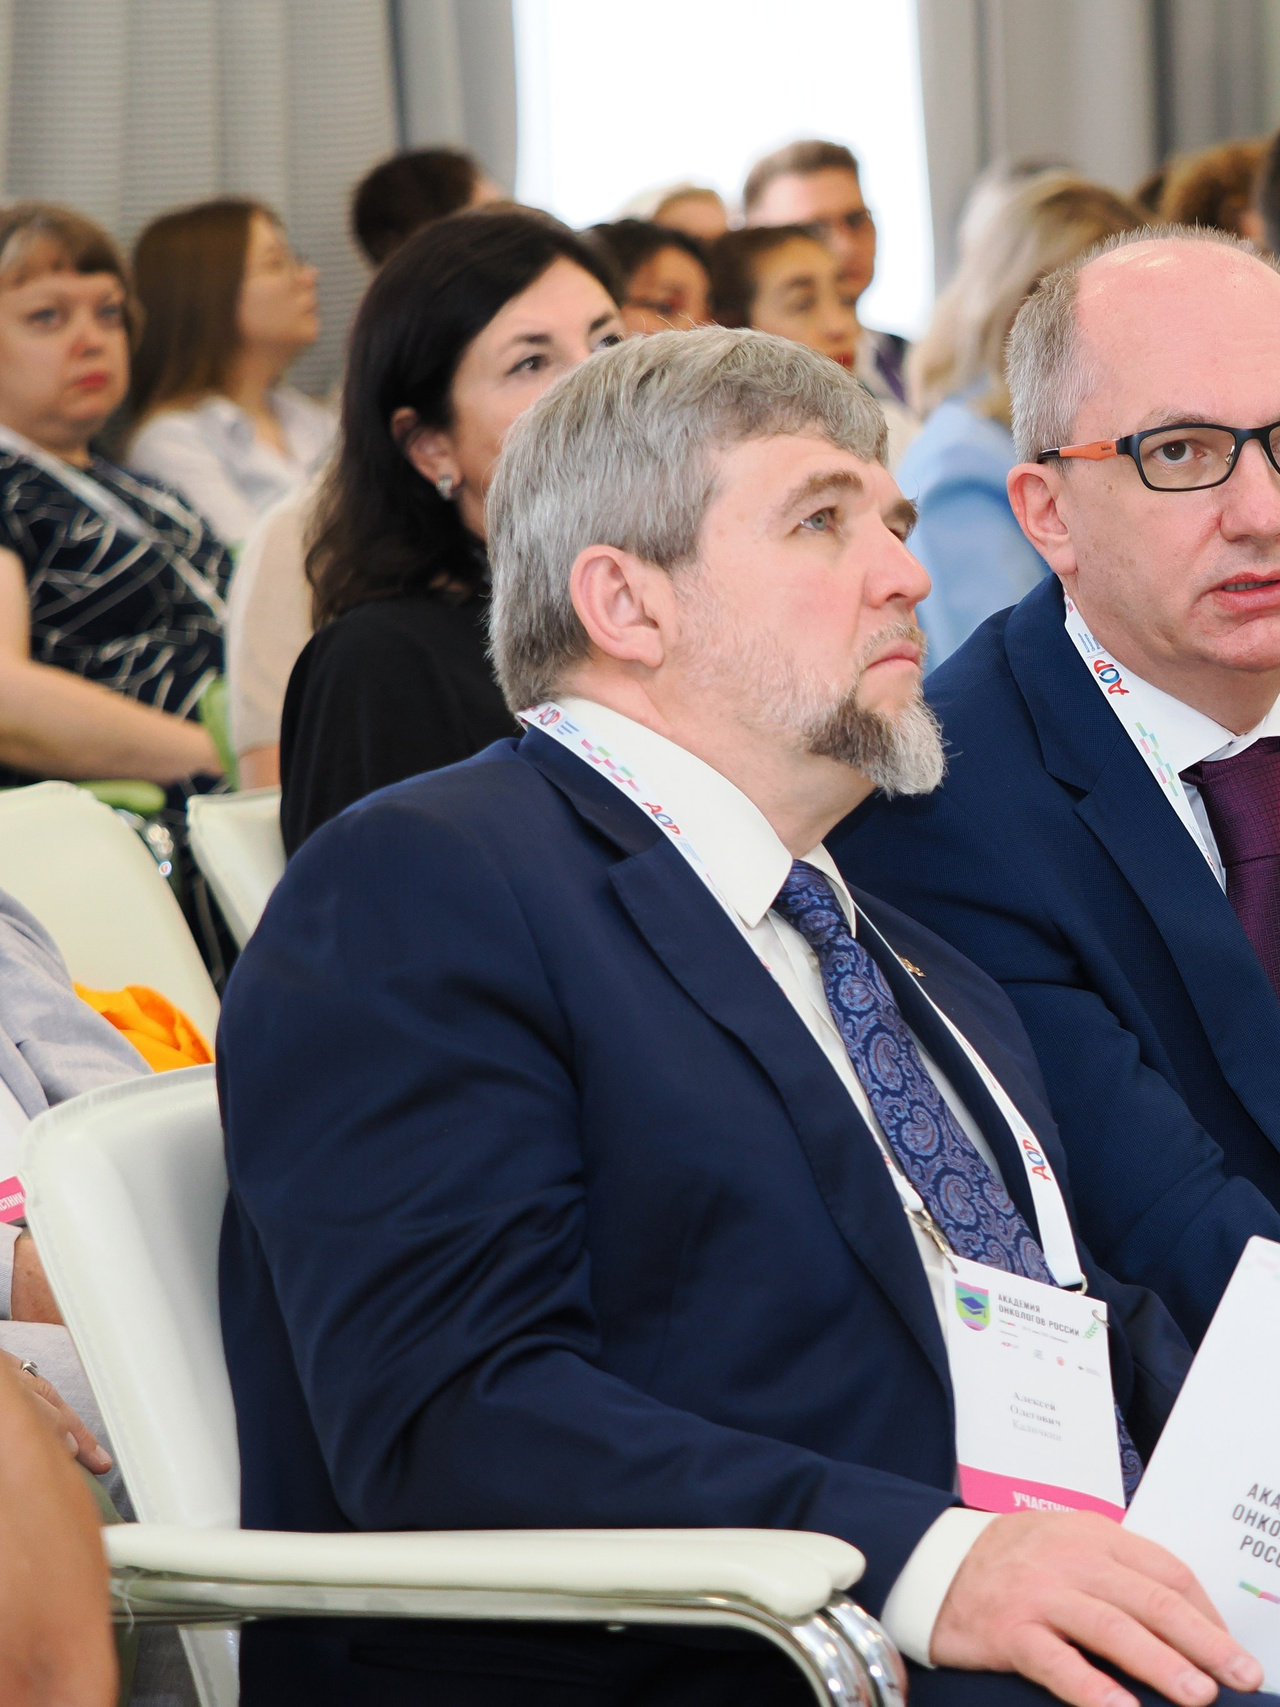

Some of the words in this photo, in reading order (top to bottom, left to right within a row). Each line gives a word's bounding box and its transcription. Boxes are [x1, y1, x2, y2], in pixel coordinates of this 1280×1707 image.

[998, 1293, 1041, 1313] АКАДЕМИЯ
[998, 1304, 1046, 1326] ОНКОЛОГОВ
[1049, 1321, 1080, 1337] РОССИИ
